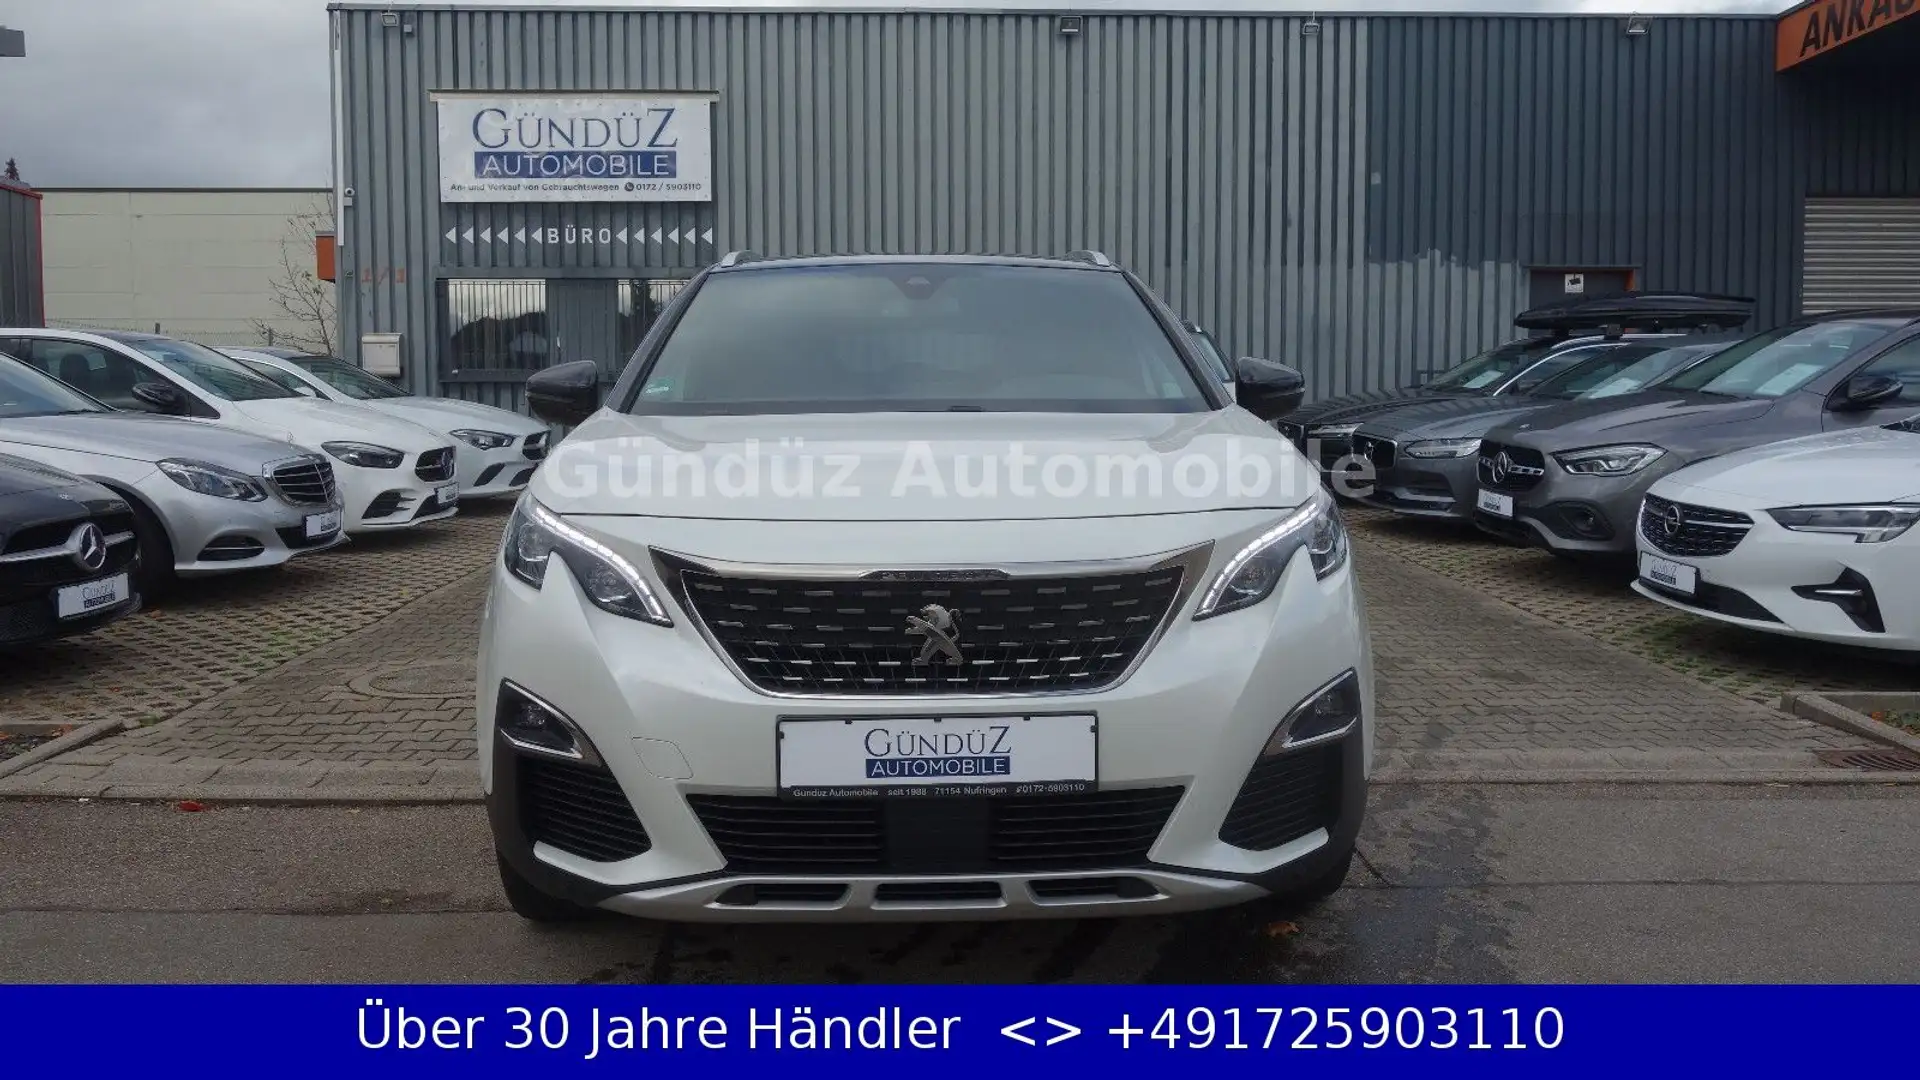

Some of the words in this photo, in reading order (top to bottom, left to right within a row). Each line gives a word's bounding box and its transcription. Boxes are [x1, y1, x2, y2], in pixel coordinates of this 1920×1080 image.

[482, 154, 670, 177] AUTOMOBILE
[468, 183, 485, 192] und
[487, 183, 521, 192] Verkauf
[523, 184, 539, 192] von
[635, 183, 658, 192] 0172
[665, 183, 702, 192] 5903110
[547, 224, 612, 245] BÜRO
[871, 757, 1006, 777] AUTOMOBILE
[829, 787, 879, 797] Automobile
[934, 786, 961, 795] 71154
